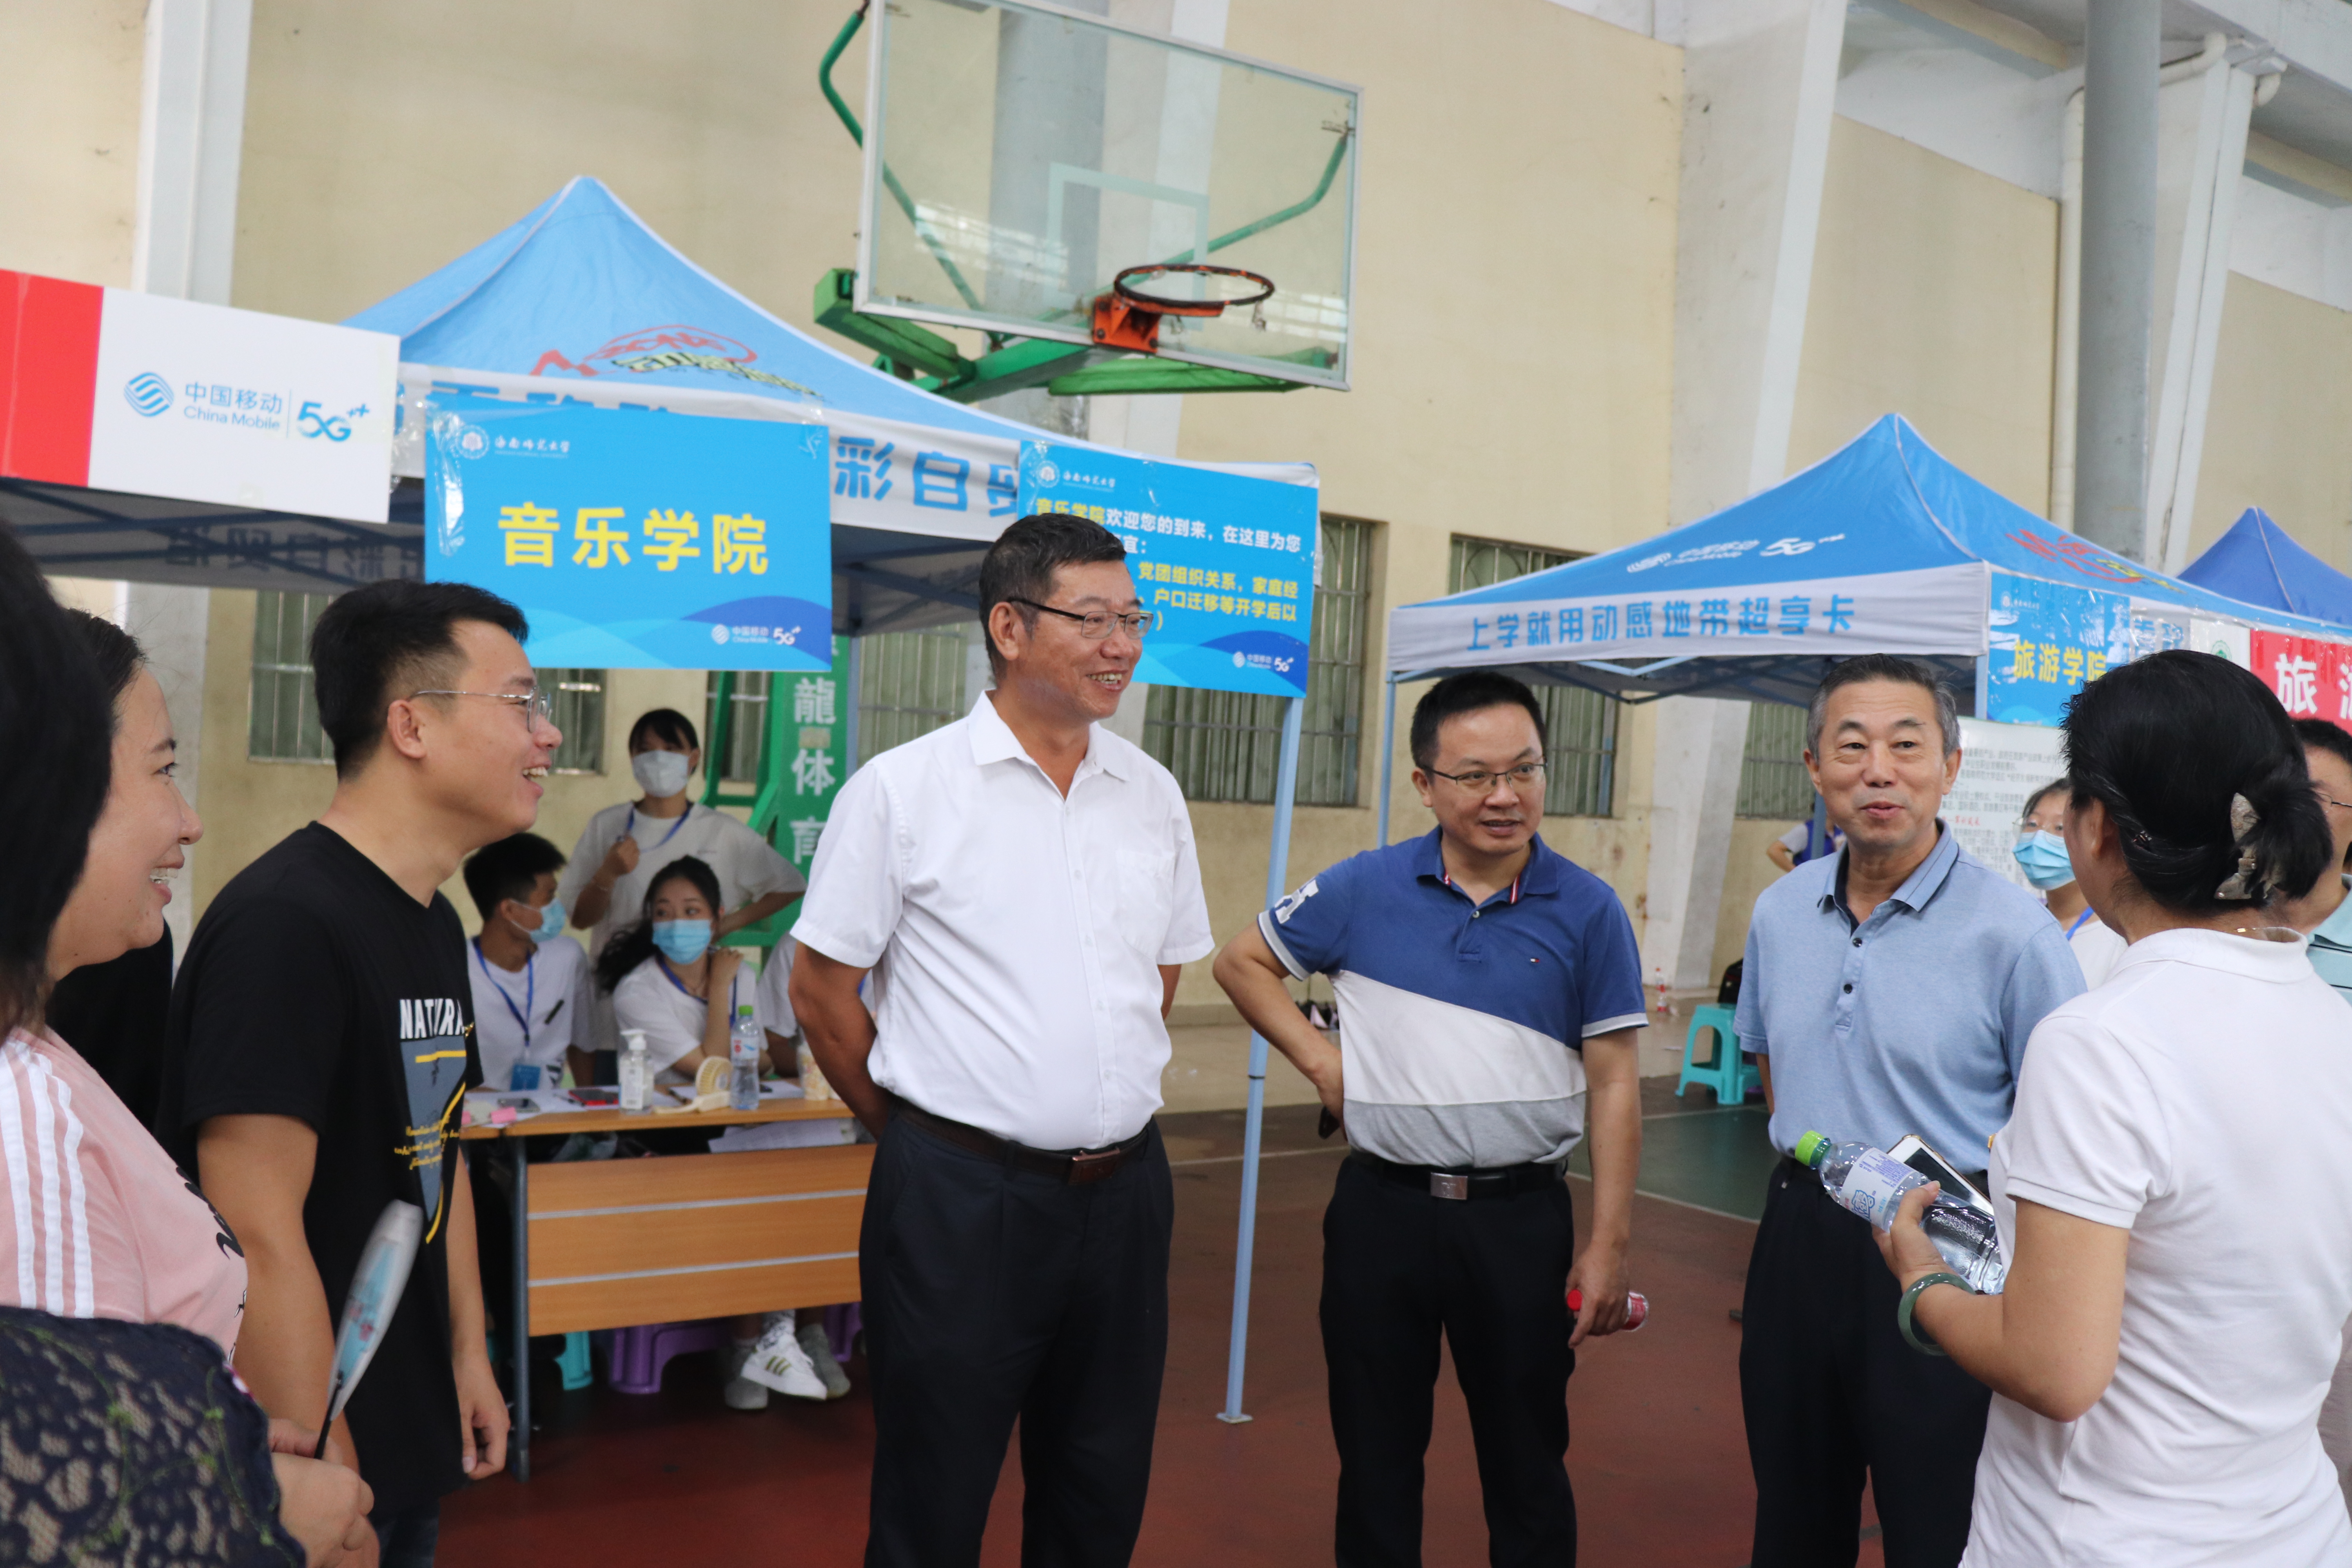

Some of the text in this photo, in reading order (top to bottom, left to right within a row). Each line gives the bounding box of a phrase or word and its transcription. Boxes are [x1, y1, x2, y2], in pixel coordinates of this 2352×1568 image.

[185, 382, 283, 414] 中国移动
[184, 405, 280, 431] China Mobile
[498, 503, 769, 575] 音乐学院
[1114, 534, 1147, 554] 宜：
[1467, 594, 1854, 651] 上学就用动感地带超享卡
[2013, 639, 2107, 686] 旅游学院
